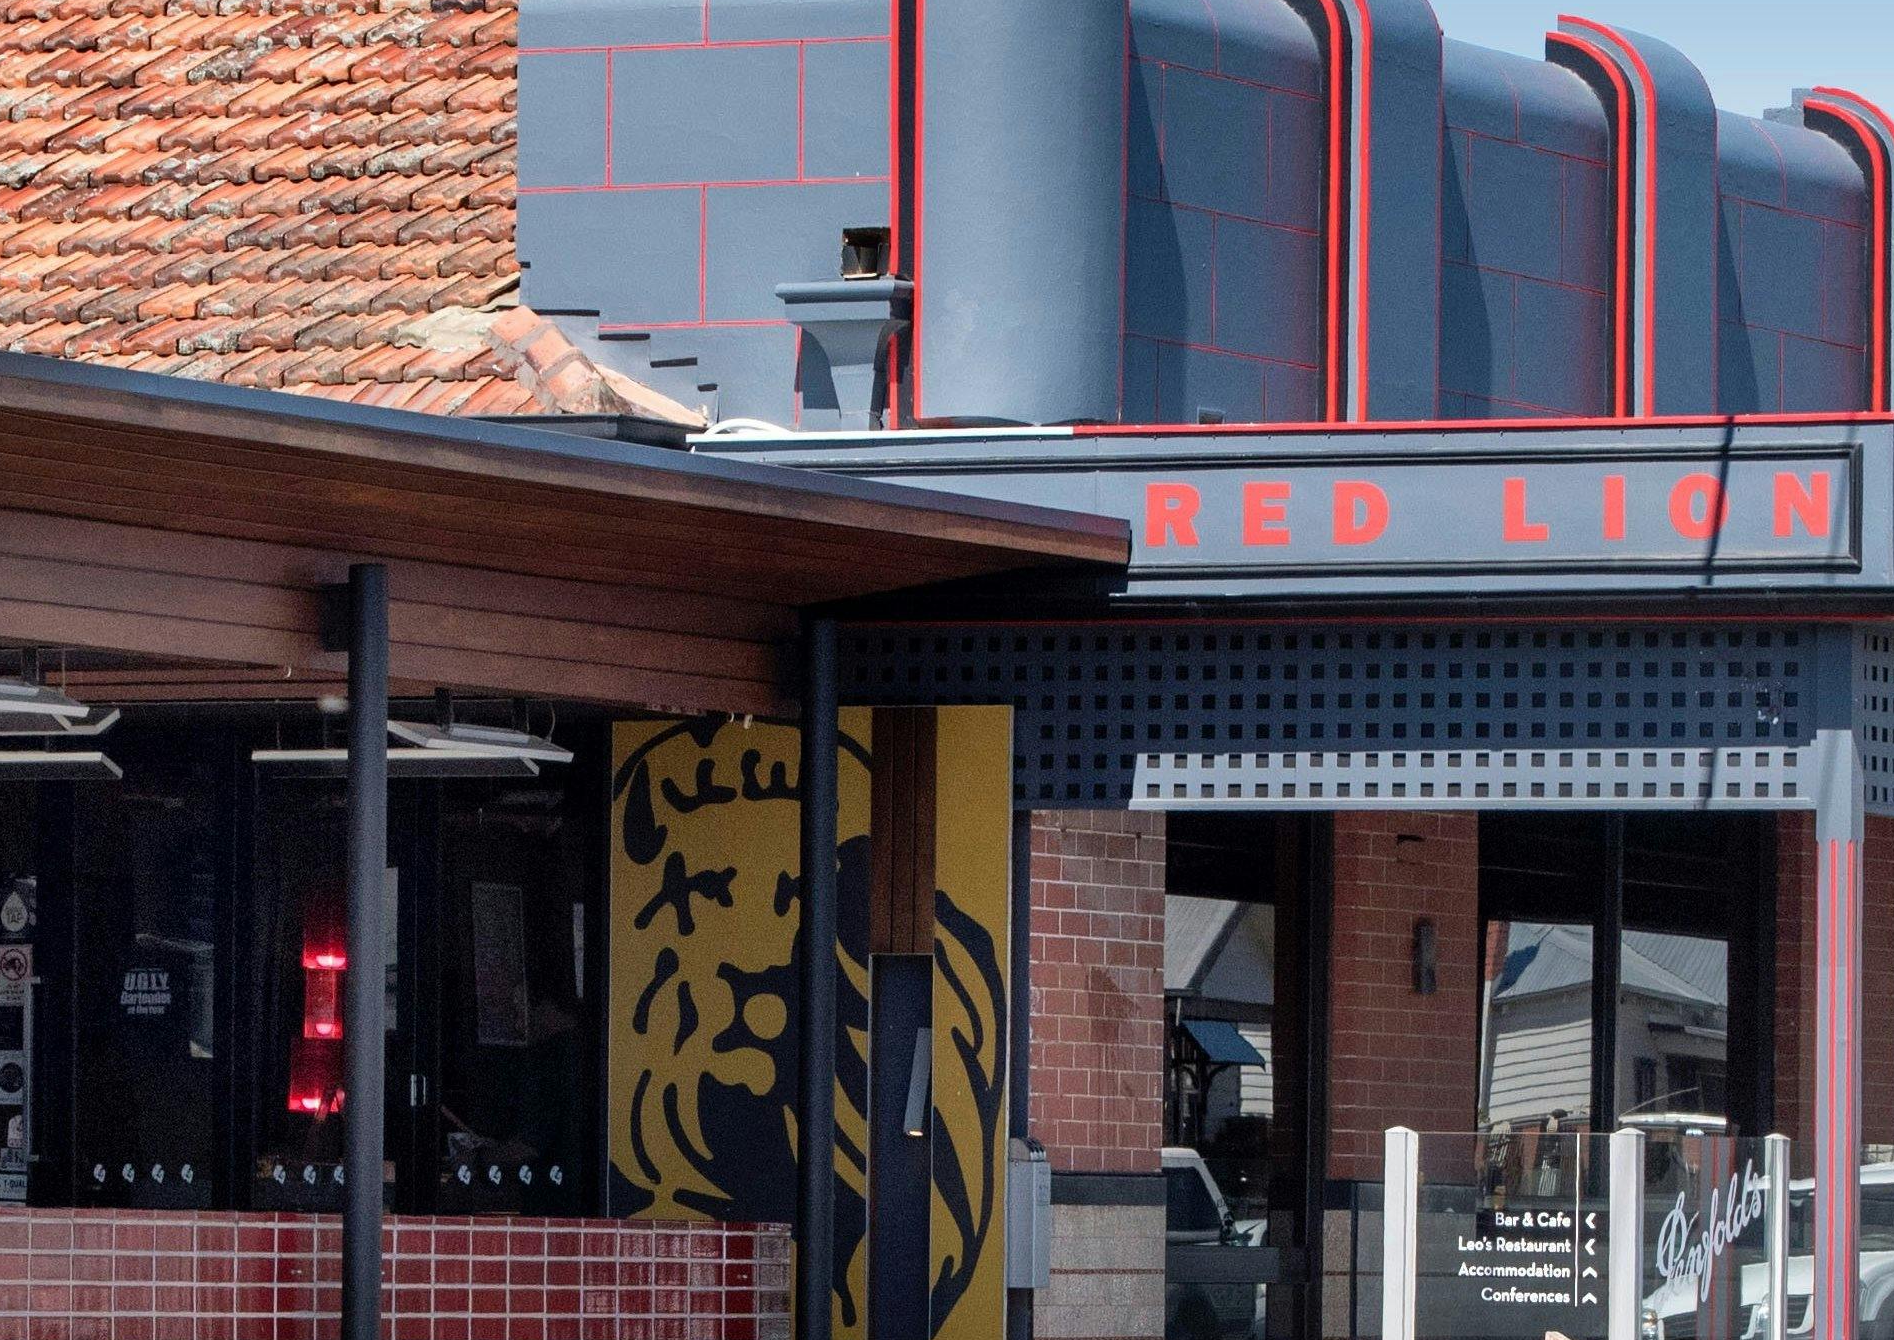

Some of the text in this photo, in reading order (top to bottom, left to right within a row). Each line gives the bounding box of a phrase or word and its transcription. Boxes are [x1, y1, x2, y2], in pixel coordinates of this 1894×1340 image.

[1144, 471, 1831, 548] RED LION
[1495, 1211, 1571, 1227] Bar & Cafe
[1656, 1157, 1762, 1303] Penfolds
[1458, 1235, 1571, 1253] Leo's Restaurant
[1458, 1262, 1571, 1278] Accommodation
[1481, 1286, 1571, 1303] Conferences
